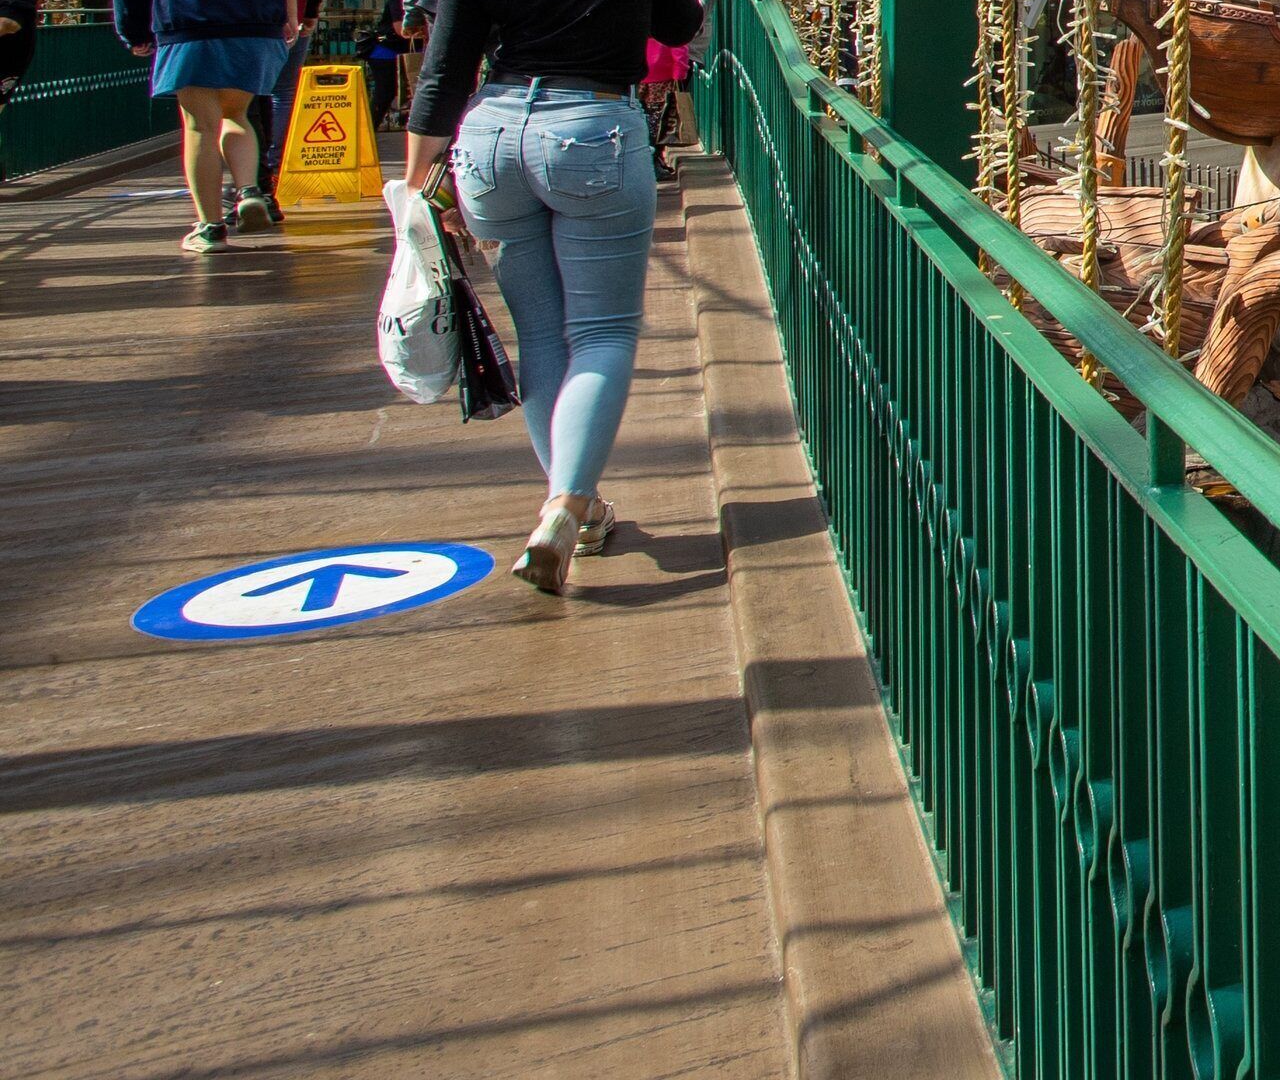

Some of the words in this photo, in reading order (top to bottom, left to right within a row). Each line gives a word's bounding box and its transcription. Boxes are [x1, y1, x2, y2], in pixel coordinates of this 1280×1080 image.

[310, 94, 347, 103] CAUTION
[300, 145, 347, 154] ATTENTION
[301, 152, 345, 160] PLANCHER
